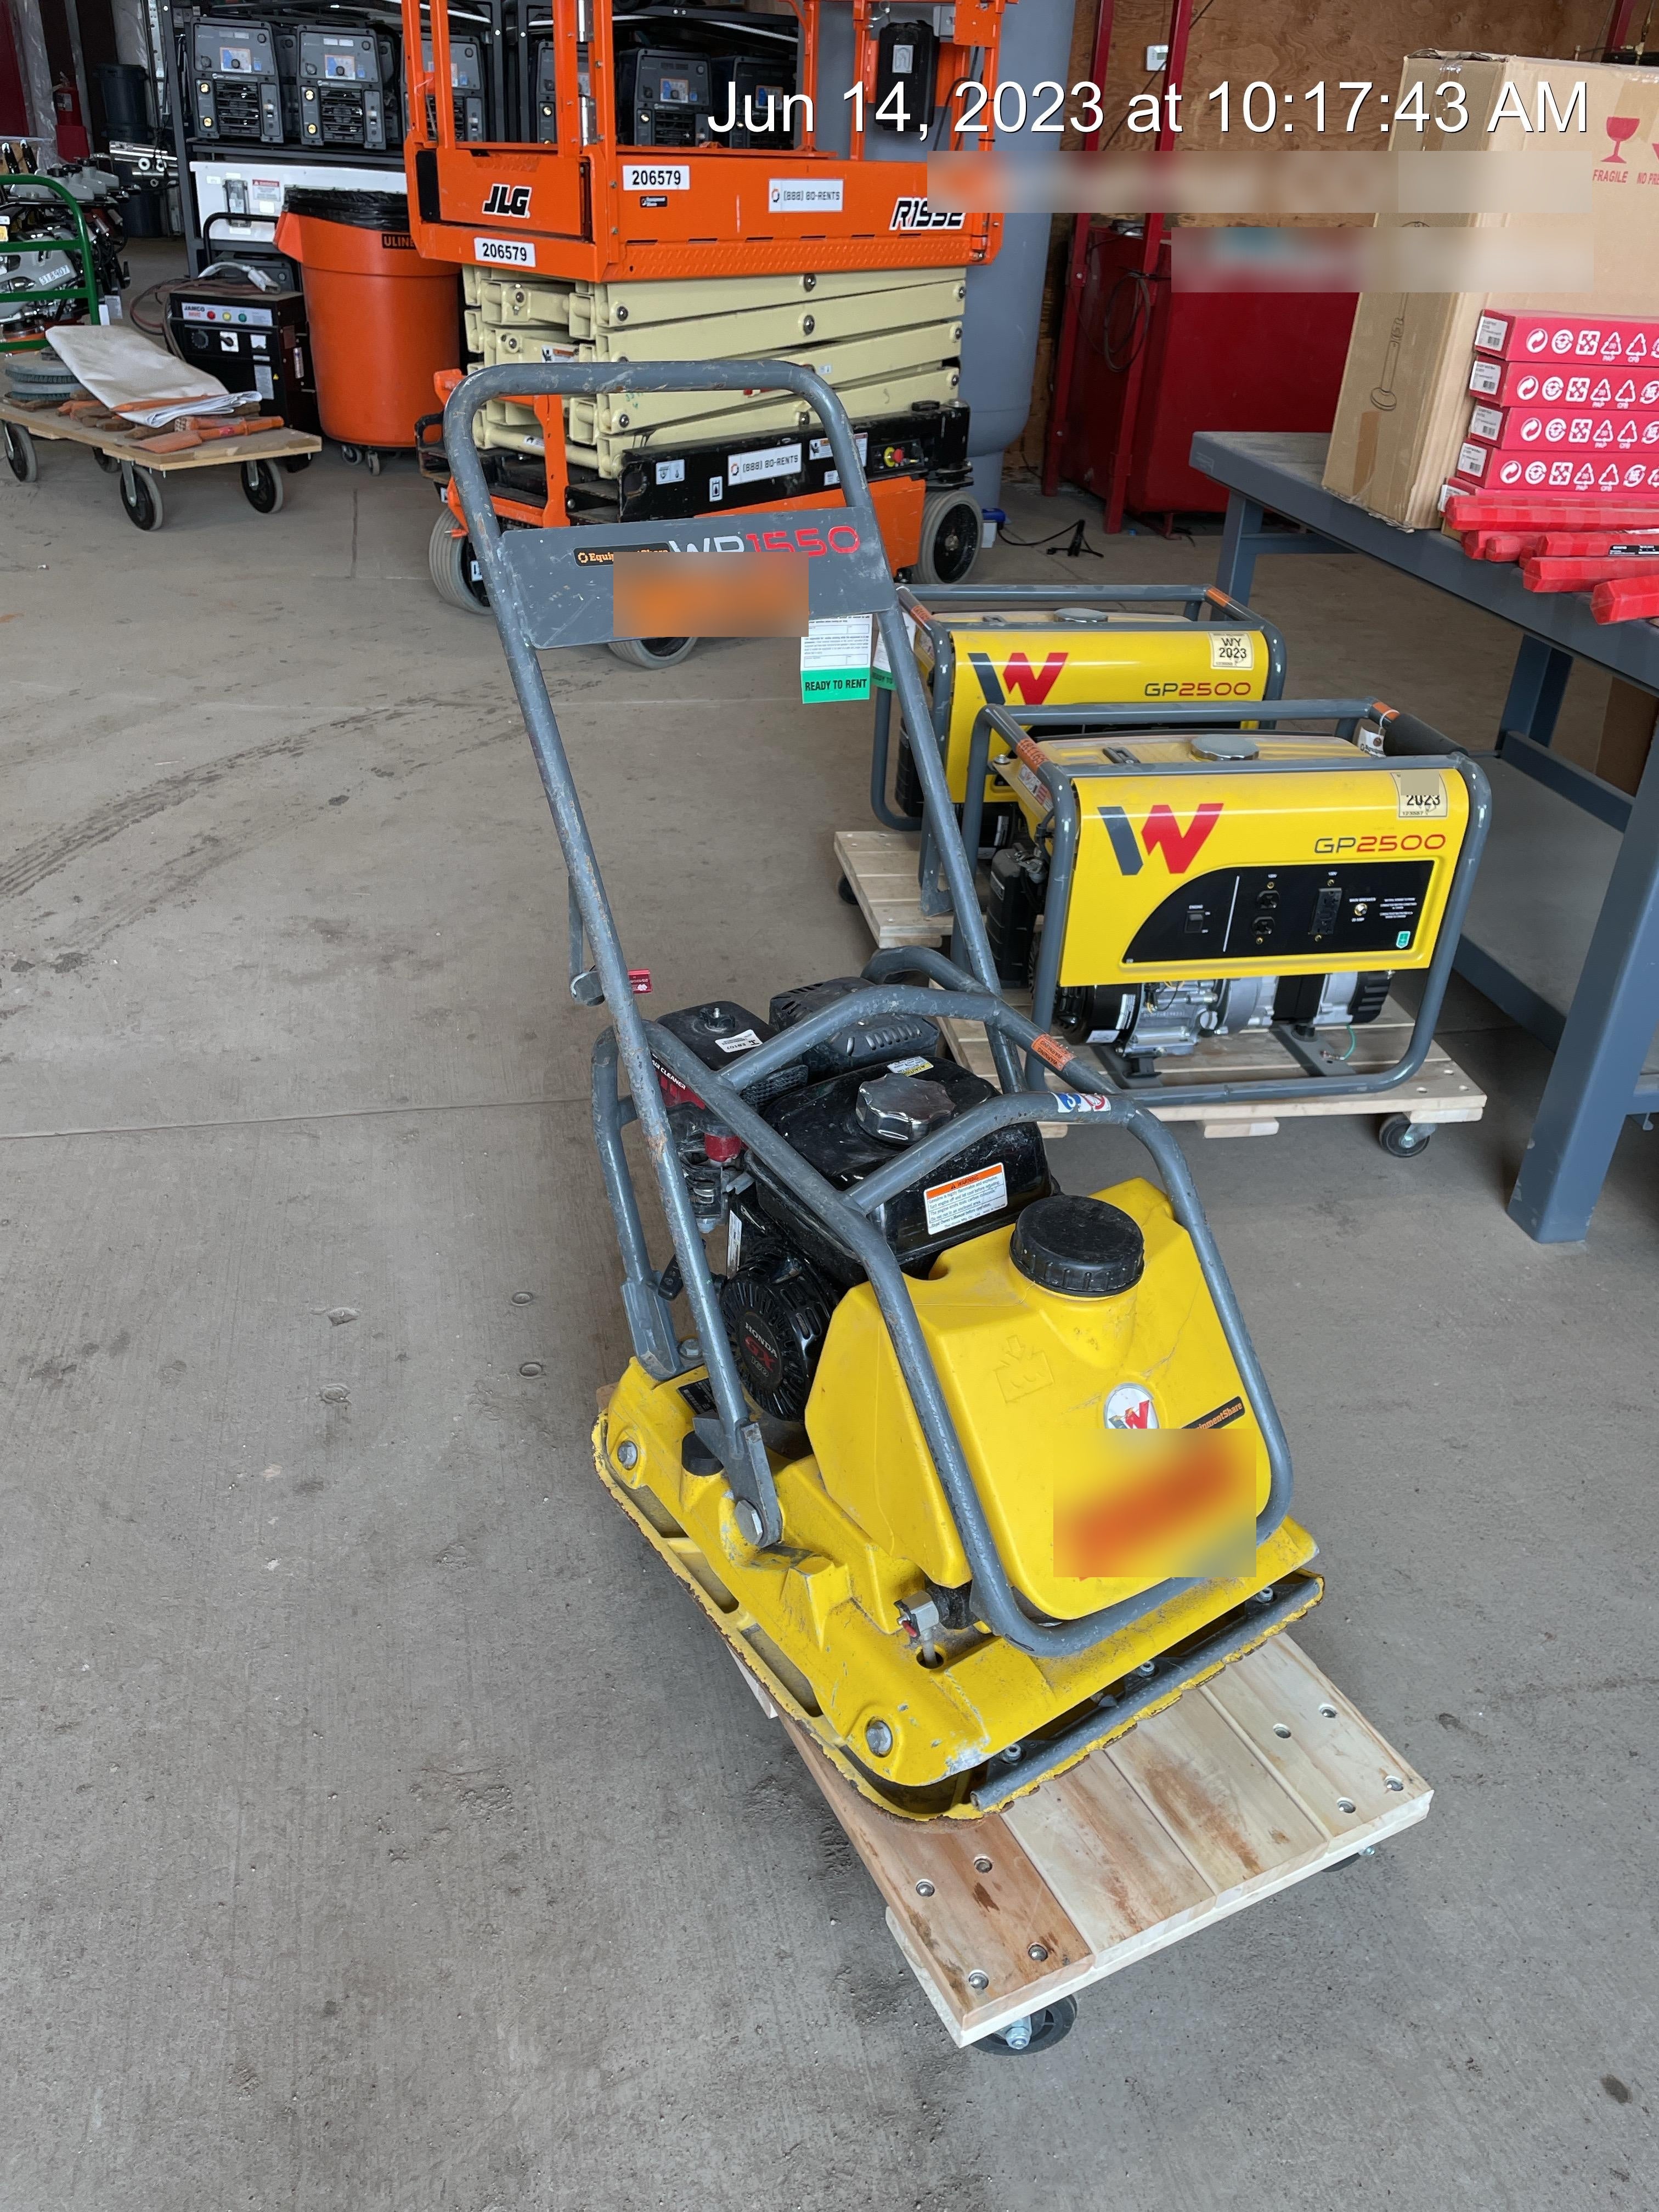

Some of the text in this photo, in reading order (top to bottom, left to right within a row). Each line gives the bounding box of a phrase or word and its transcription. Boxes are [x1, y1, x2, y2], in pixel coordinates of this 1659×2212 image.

[631, 170, 681, 186] 206579
[1592, 169, 1629, 183] FRAGILE
[483, 185, 530, 216] JLG
[783, 190, 804, 201] (888)
[482, 242, 527, 262] 206579
[742, 461, 763, 473] (888)
[1221, 638, 1242, 646] WY
[1219, 647, 1246, 658] 2023
[805, 678, 867, 691] READY TO RENT
[1144, 682, 1251, 697] GP2500
[1313, 834, 1446, 853] GP2500
[1037, 1047, 1058, 1066] WARNING
[661, 1067, 686, 1090] CLEANER
[958, 1175, 979, 1186] WARNING
[745, 1321, 778, 1359] HONDA
